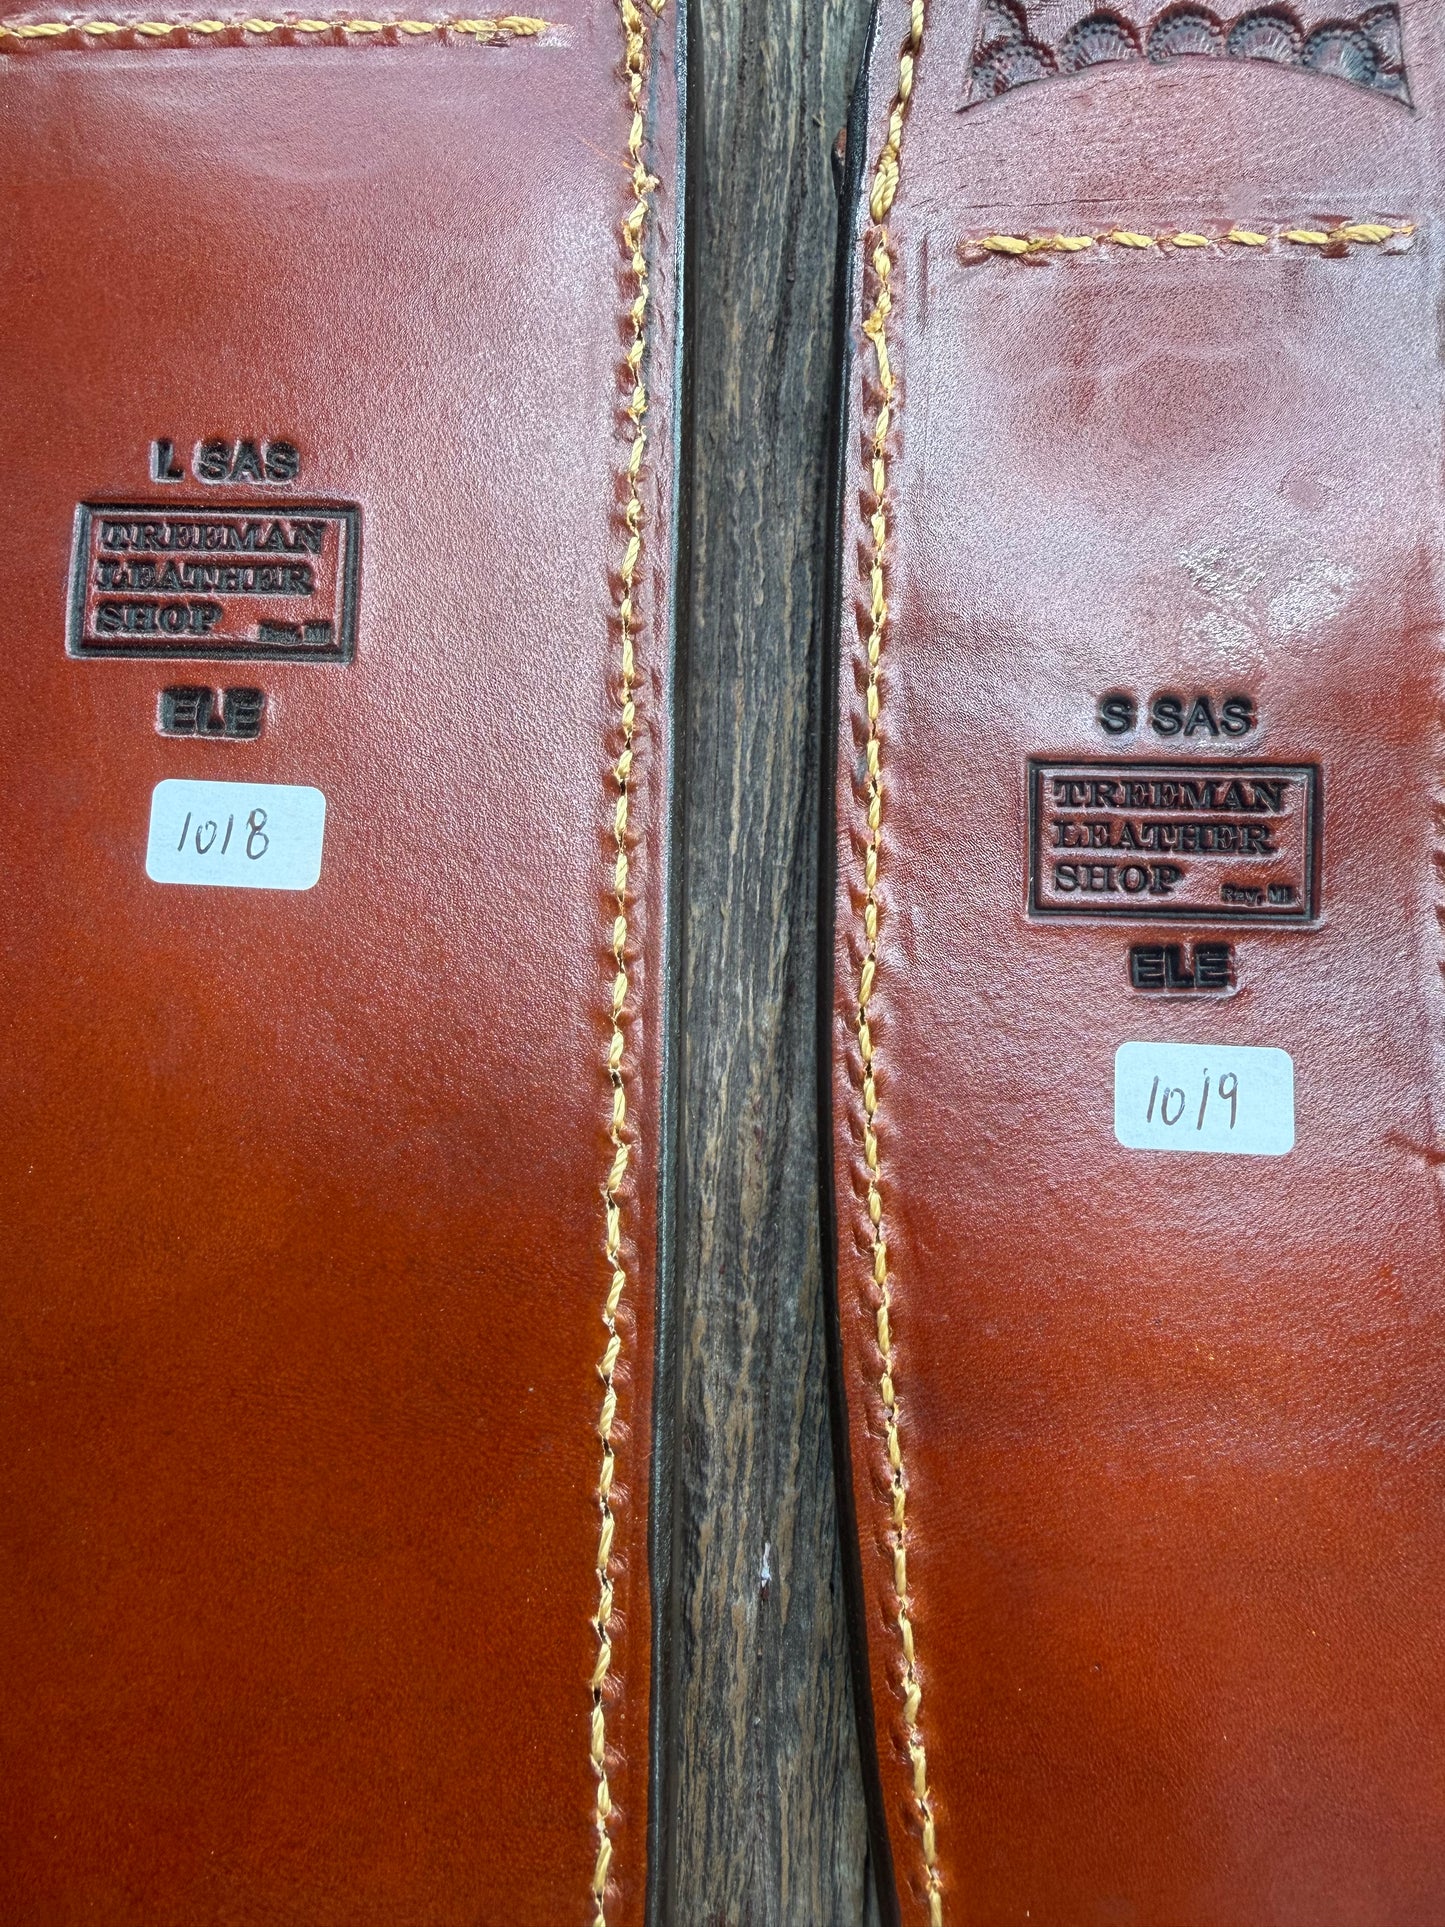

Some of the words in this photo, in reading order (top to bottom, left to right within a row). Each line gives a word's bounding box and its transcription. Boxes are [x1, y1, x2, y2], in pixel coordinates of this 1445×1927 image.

[150, 438, 186, 482] L
[196, 438, 299, 485] SAS
[100, 520, 325, 555] TREEMAN
[97, 562, 315, 595] LEATHER
[96, 602, 223, 636] SHOP
[158, 686, 267, 738] ELE
[1100, 695, 1138, 735] S
[1150, 694, 1253, 737] SAS
[1053, 778, 1286, 811] TREEMAN
[176, 807, 270, 861] 1018
[1053, 822, 1276, 853] LEATHER
[1053, 864, 1184, 894] SHOP
[1130, 944, 1230, 988] ELE
[1146, 1067, 1239, 1131] 1019
